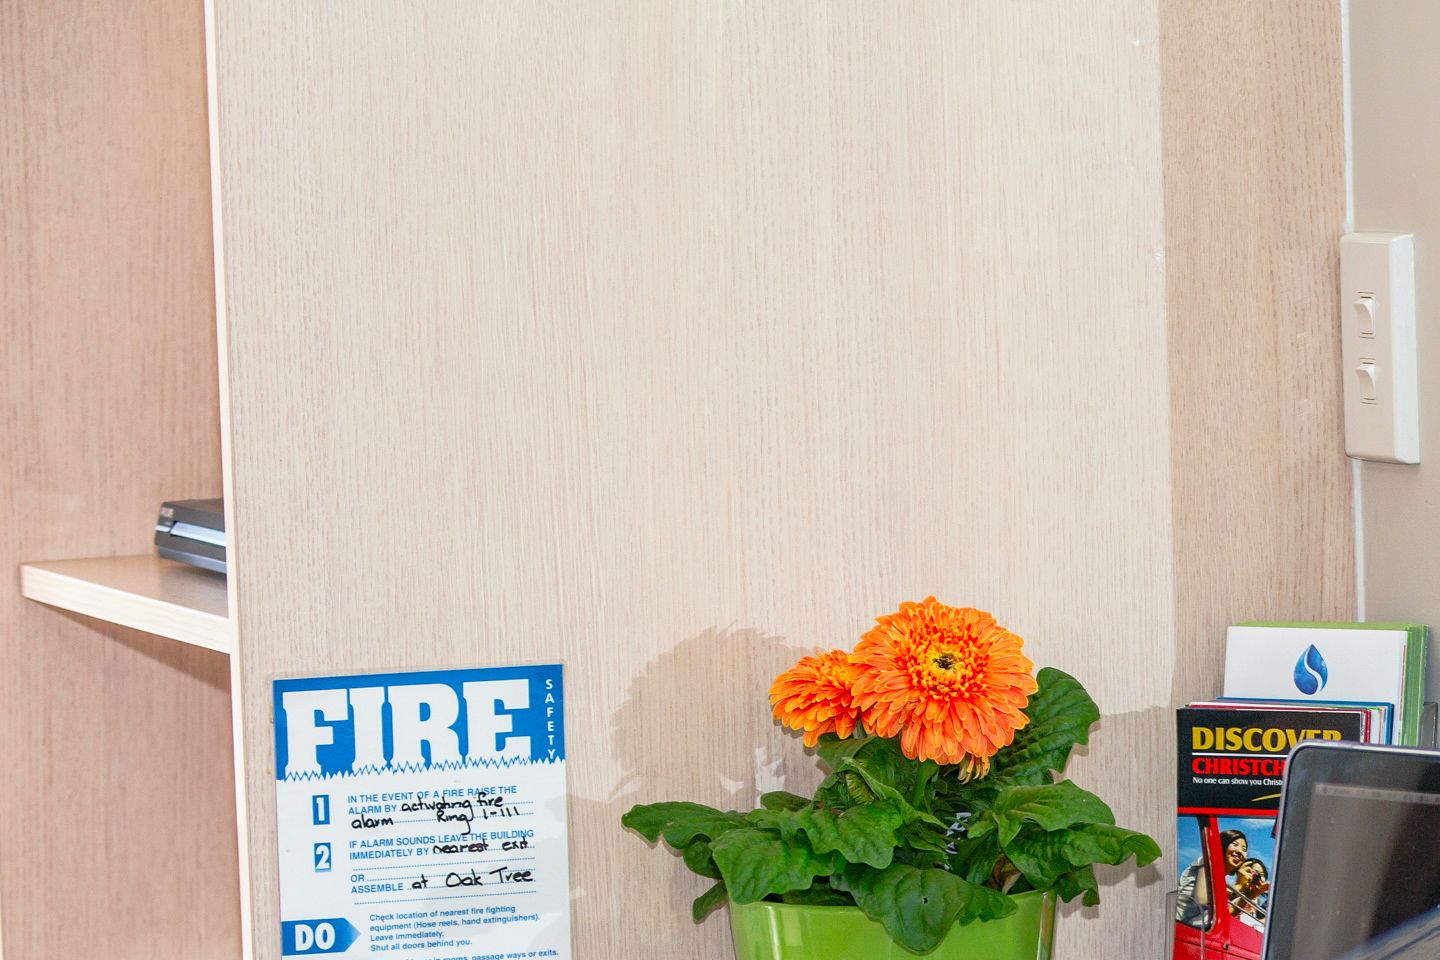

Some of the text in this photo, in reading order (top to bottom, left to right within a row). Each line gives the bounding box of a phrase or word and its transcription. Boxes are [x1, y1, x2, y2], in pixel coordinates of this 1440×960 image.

[544, 679, 556, 760] SAFETY
[282, 679, 531, 781] FIRE
[1231, 777, 1248, 785] show
[360, 794, 378, 802] THE
[382, 792, 413, 801] EVENT
[417, 791, 430, 799] OF
[468, 787, 496, 796] RAISE
[314, 796, 328, 824] 1
[349, 805, 381, 815] ALARM
[385, 804, 397, 812] BY
[352, 814, 393, 829] alarm
[349, 829, 534, 848] IF ALARM SOUNDS LEAVE THE BUILDING
[314, 843, 330, 871] 2
[349, 849, 412, 860] IMMEDIATELY
[416, 848, 429, 856] BY
[351, 874, 364, 882] OR
[351, 866, 533, 894] ASSEMBLE at Oak Tree
[370, 913, 394, 922] Check
[440, 909, 469, 917] nearest
[486, 906, 516, 914] fighting
[370, 923, 411, 932] equipment
[295, 922, 335, 951] DO
[370, 931, 444, 942] Leave immediately.
[427, 940, 453, 948] behind
[506, 952, 526, 960] ways
